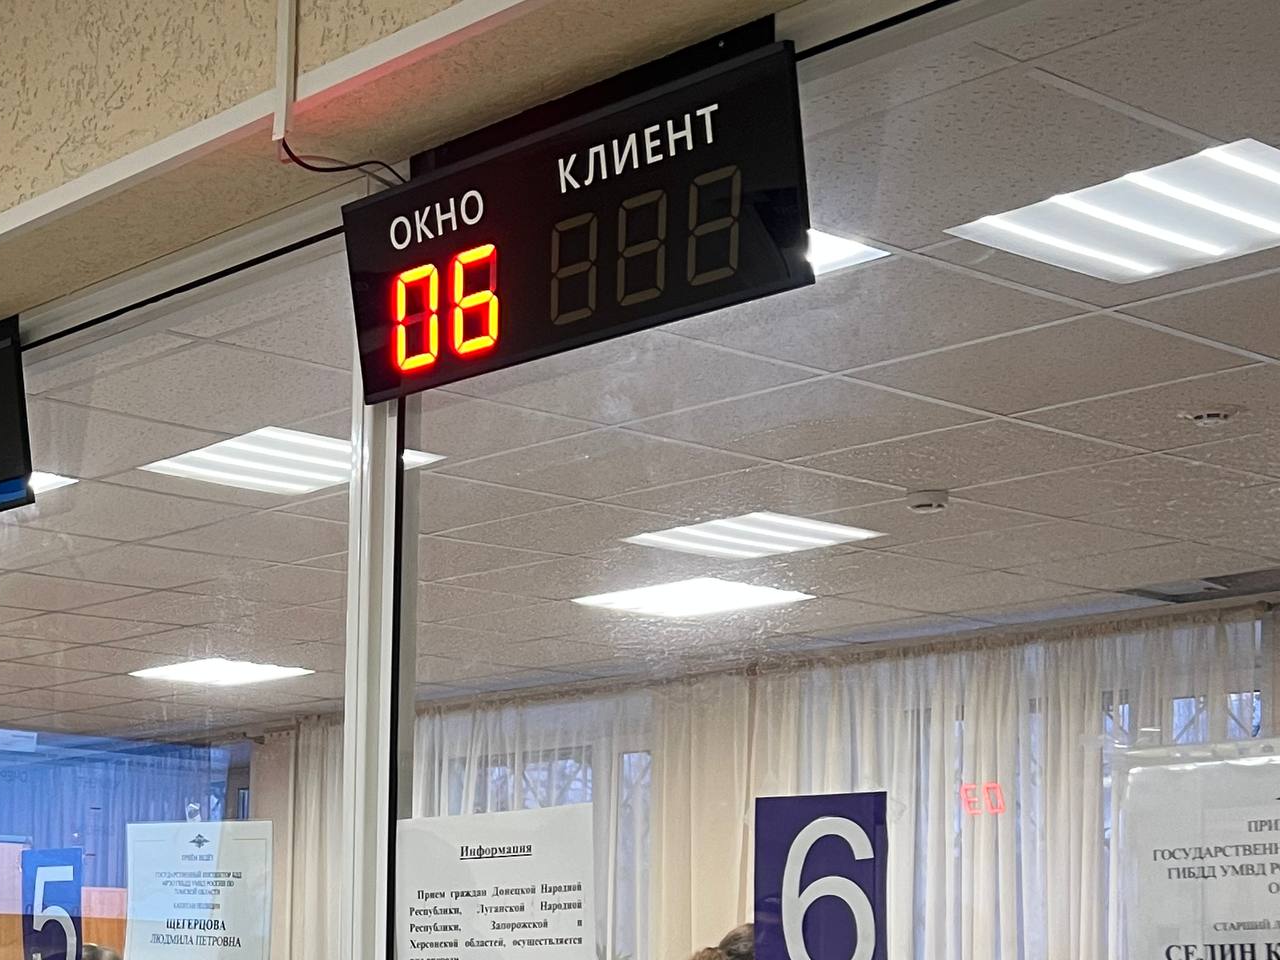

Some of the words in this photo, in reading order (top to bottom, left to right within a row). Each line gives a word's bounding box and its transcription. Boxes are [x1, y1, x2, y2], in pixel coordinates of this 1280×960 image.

[558, 104, 719, 193] КЛИЕНТ
[389, 190, 484, 250] ОКНО
[395, 243, 500, 371] 06
[460, 844, 532, 860] Информация
[1168, 866, 1217, 879] ГИБДД
[1220, 863, 1267, 877] УМВД
[417, 889, 445, 901] Прием
[450, 889, 487, 900] граждан
[492, 885, 536, 897] Донецкой
[541, 882, 582, 895] Народной
[409, 905, 462, 918] Республики,
[476, 902, 525, 916] Луганской
[540, 899, 582, 913] Народной
[491, 918, 548, 932] Запорожской
[150, 933, 194, 945] ЛЮДМИЛА
[195, 935, 241, 948] ПЕТРОВНА
[410, 939, 459, 951] Херсонской
[464, 937, 506, 948] областей,
[512, 937, 582, 949] осуществляется
